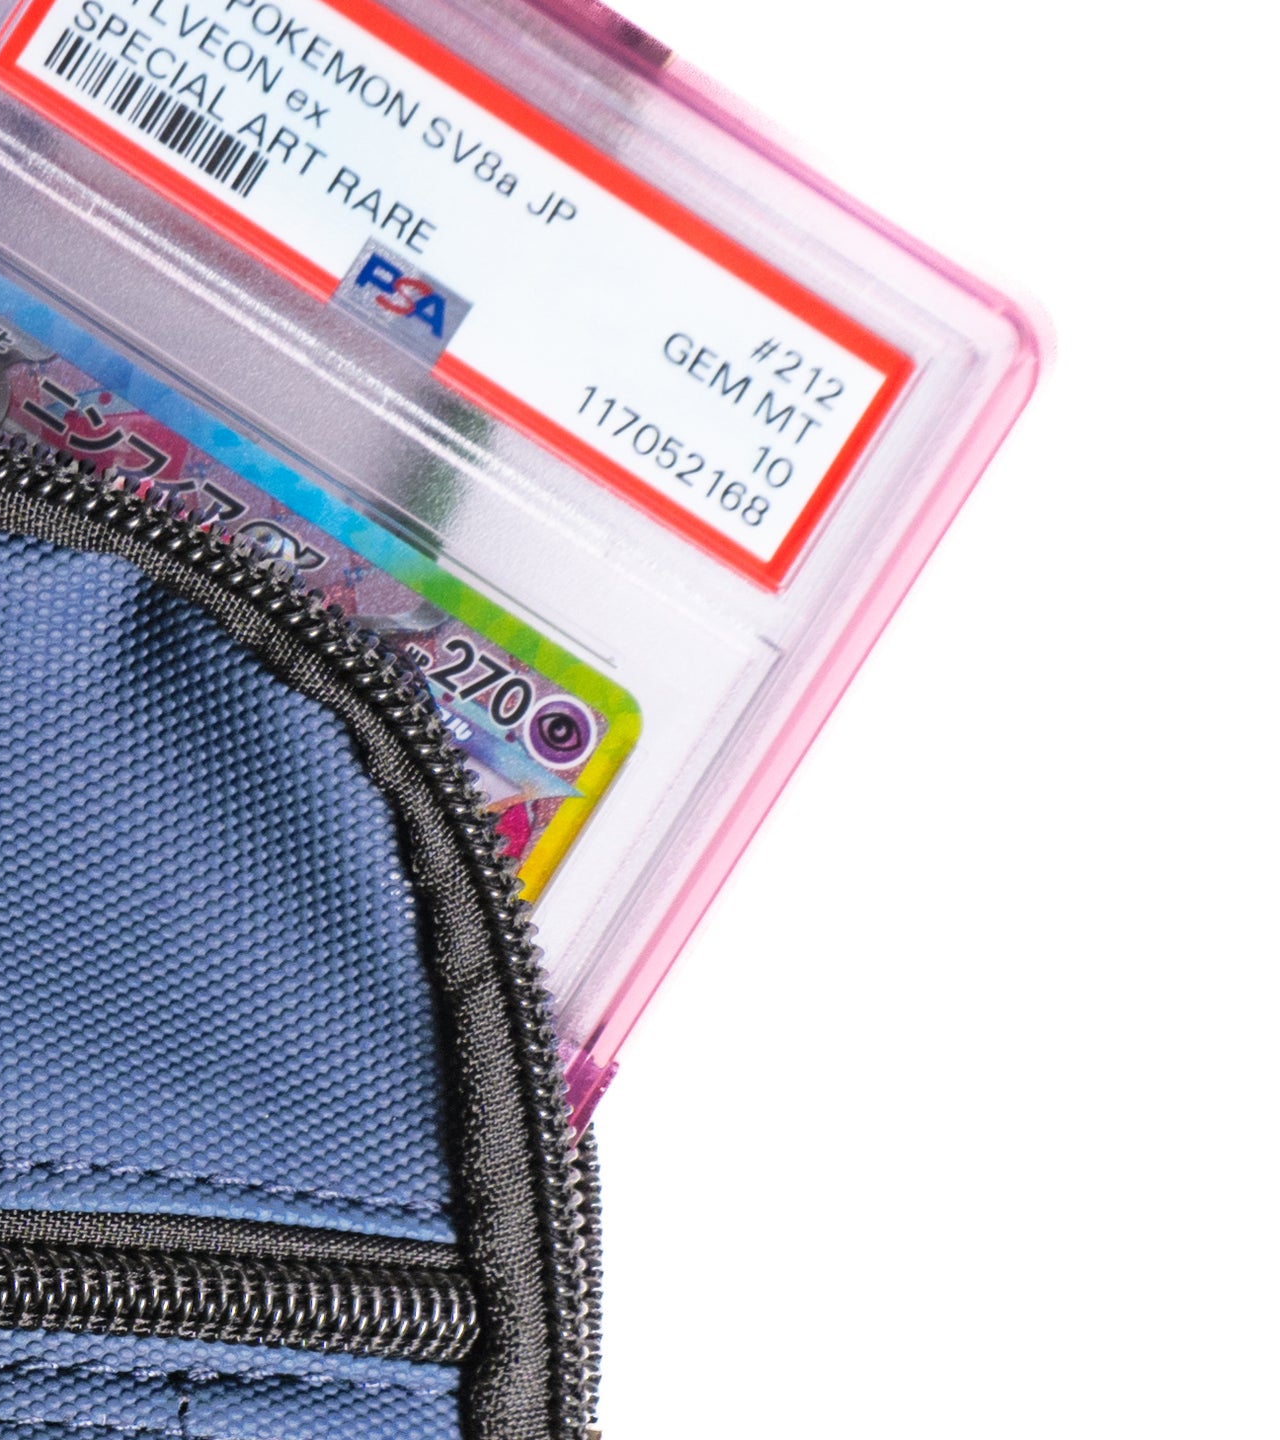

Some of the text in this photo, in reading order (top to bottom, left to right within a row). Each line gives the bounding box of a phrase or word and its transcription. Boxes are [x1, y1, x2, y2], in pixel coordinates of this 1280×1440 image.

[73, 0, 437, 255] SPECIAL ART RARE
[285, 87, 331, 128] ex
[422, 116, 519, 197] SV8a
[526, 191, 578, 225] JP
[354, 252, 447, 340] PSA
[663, 332, 823, 445] GEM MT
[750, 336, 845, 411] #212
[578, 385, 771, 527] 117052168
[752, 446, 795, 489] 10
[426, 636, 533, 728] 270
